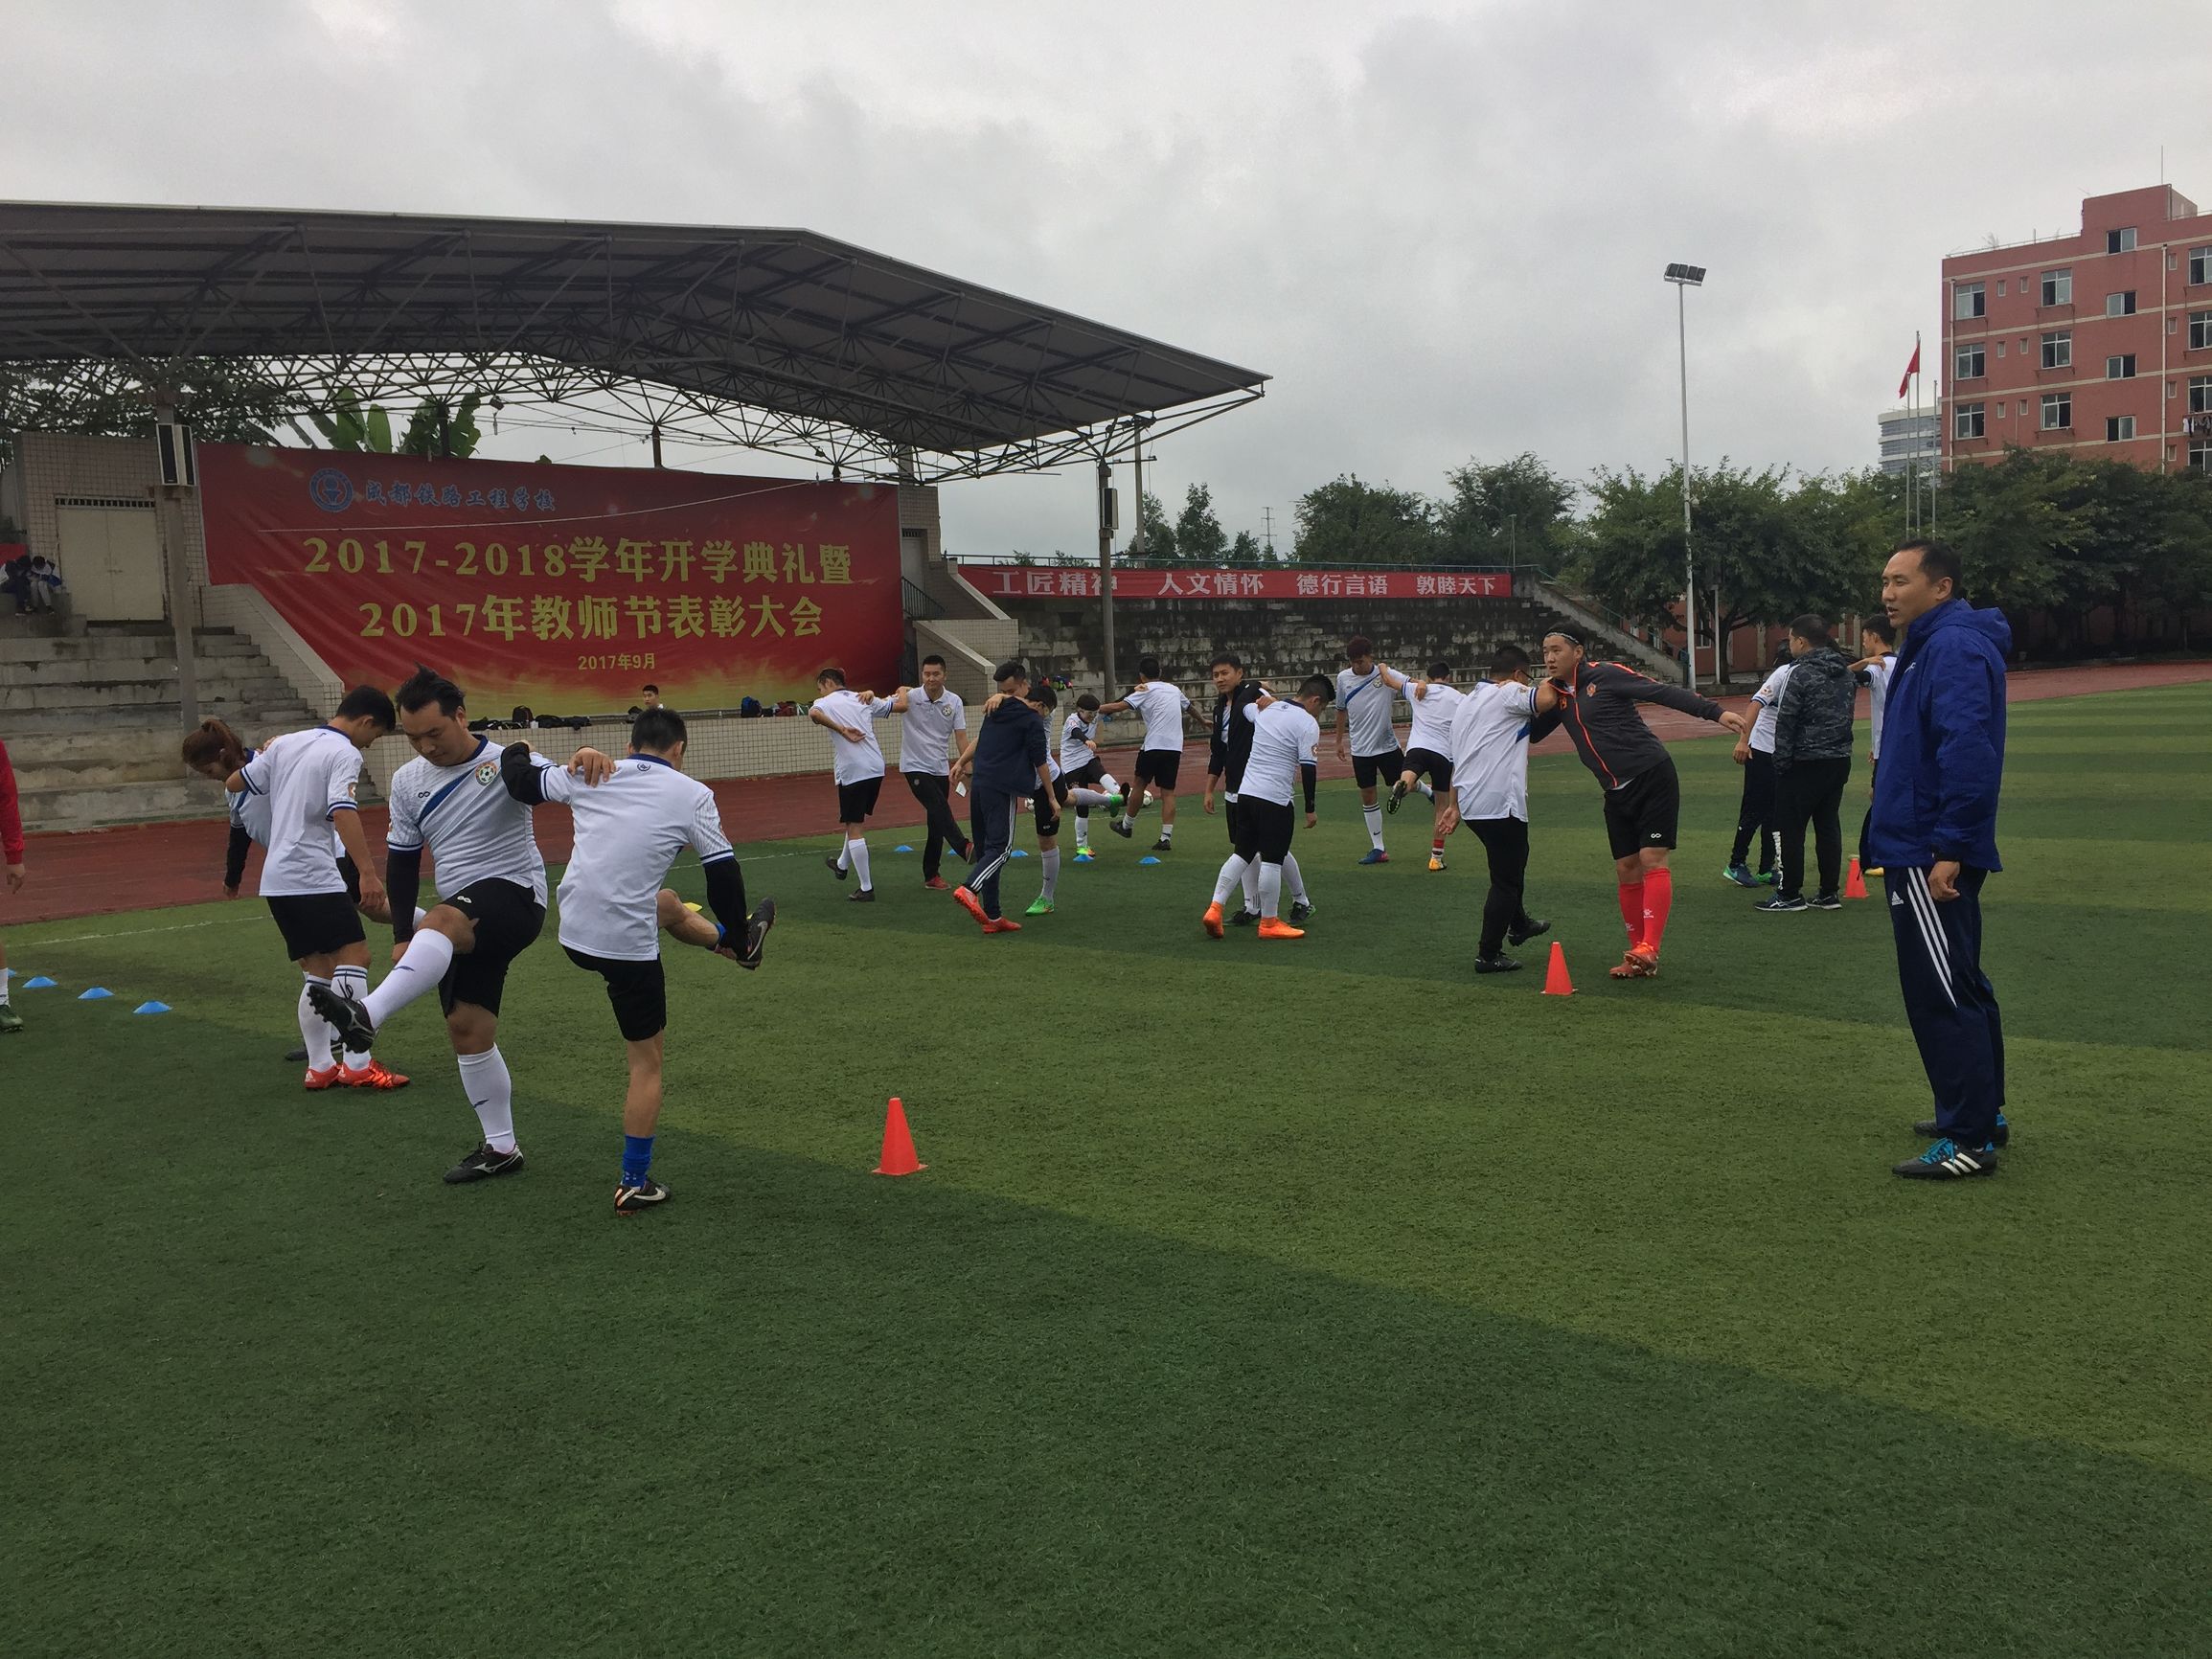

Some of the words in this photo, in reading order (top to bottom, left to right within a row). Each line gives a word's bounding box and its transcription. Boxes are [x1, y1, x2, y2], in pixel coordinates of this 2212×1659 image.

[366, 479, 556, 512] 成都铁路工程学校
[303, 536, 853, 584] 2017-2018学年开学典礼暨
[1158, 572, 1264, 596] 人文情怀
[1296, 574, 1388, 596] 德行言语
[1416, 575, 1495, 596] 敦睦天下
[359, 595, 822, 641] 2017年教师节表彰大会
[578, 653, 655, 670] 2017年9月
